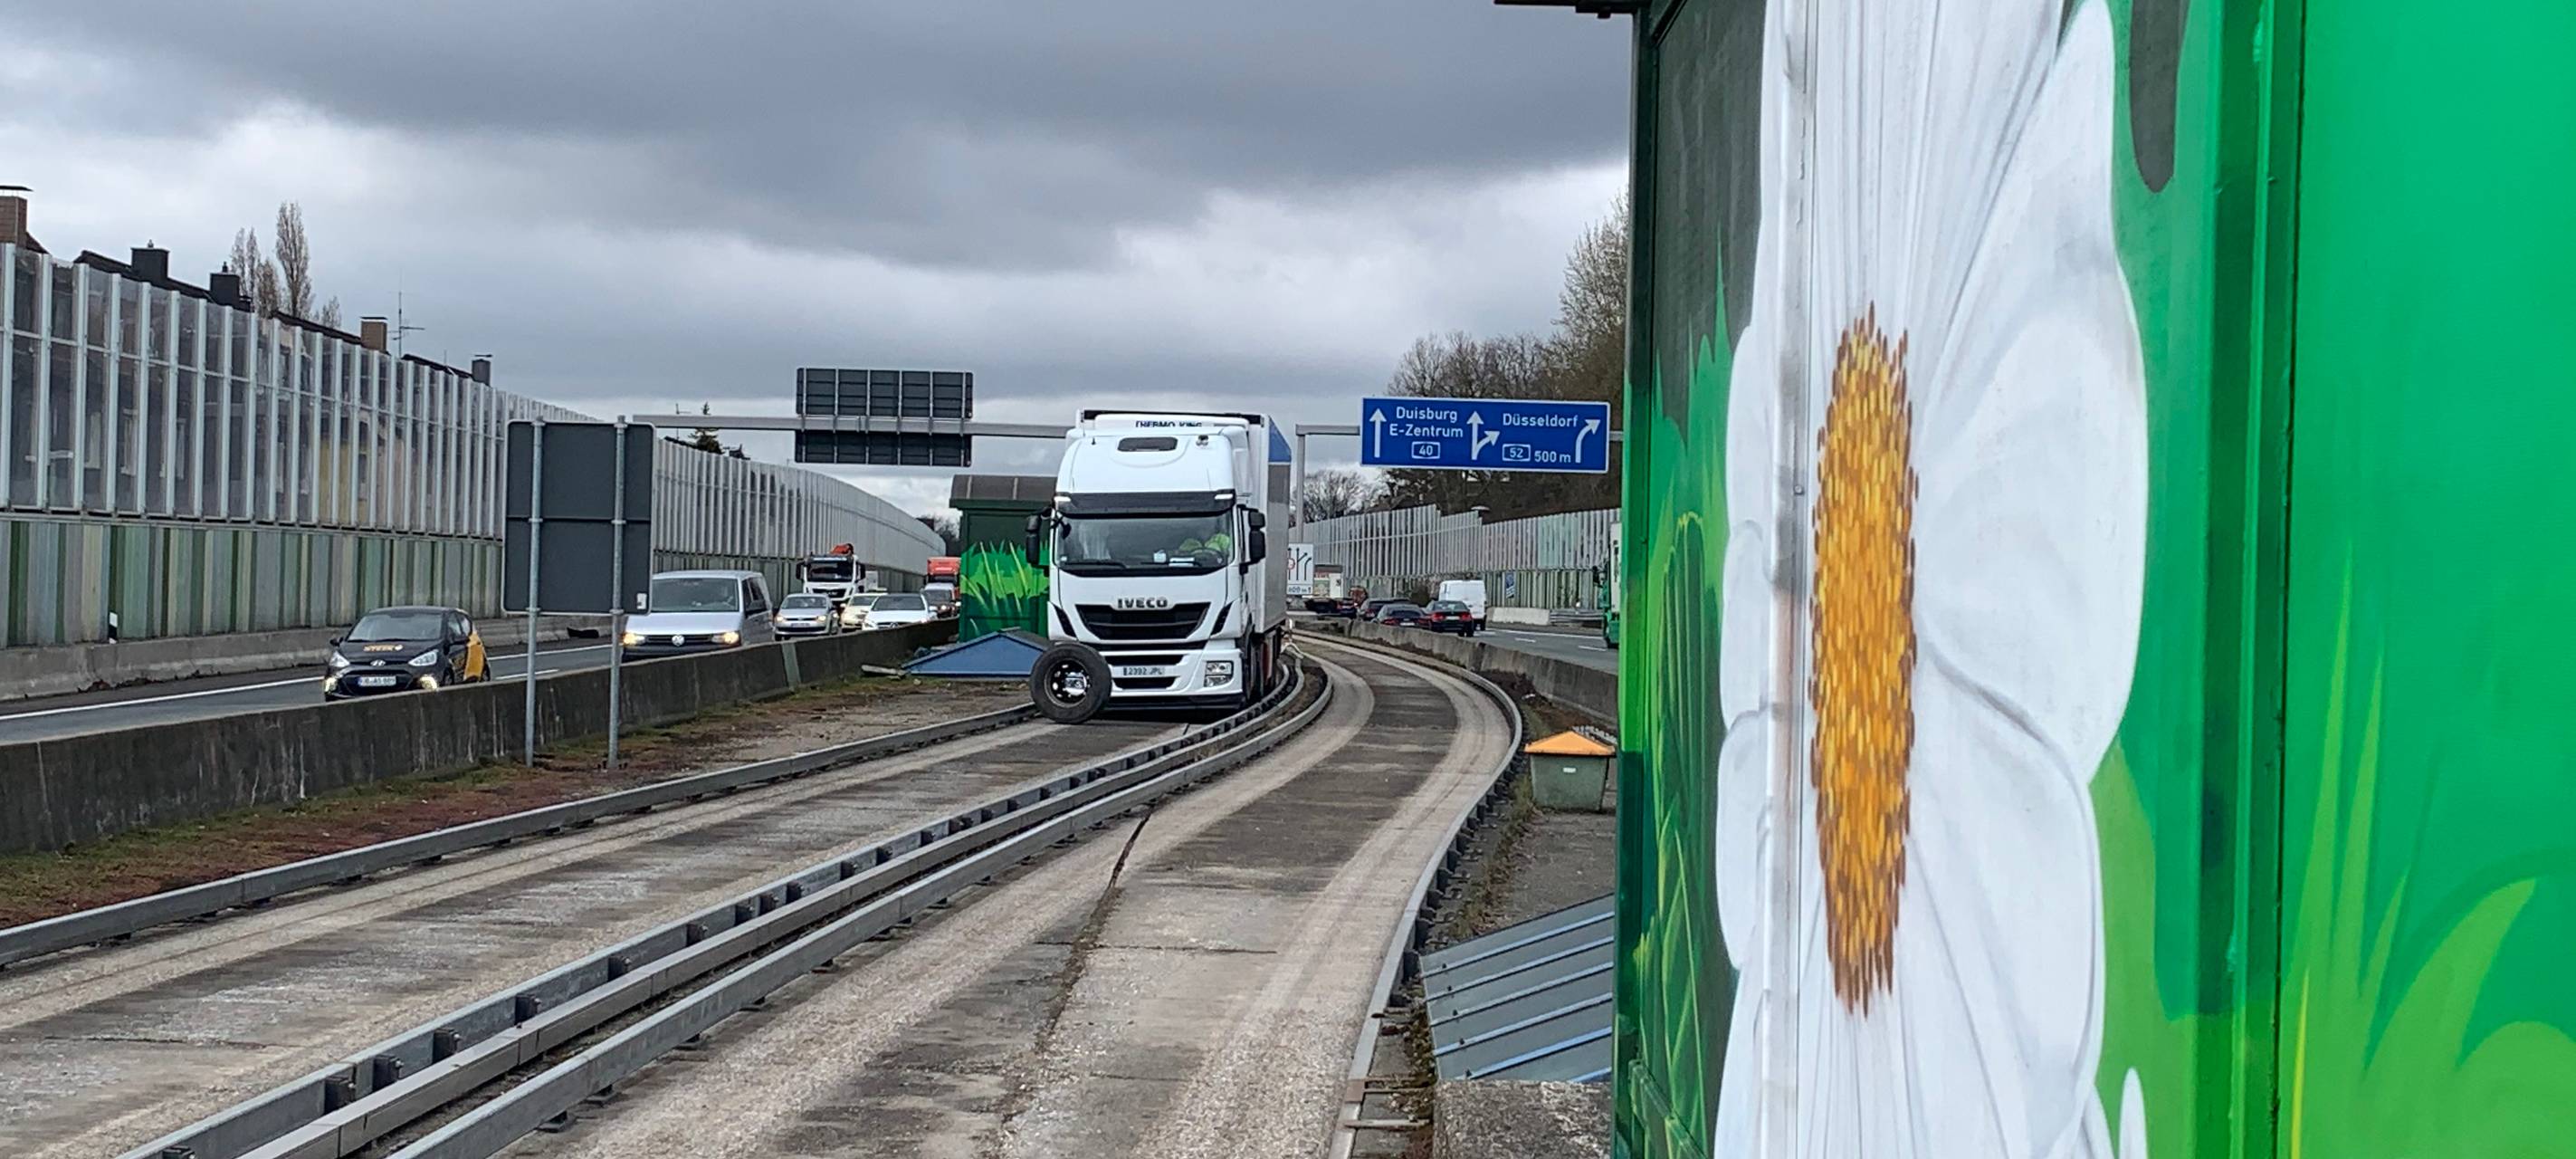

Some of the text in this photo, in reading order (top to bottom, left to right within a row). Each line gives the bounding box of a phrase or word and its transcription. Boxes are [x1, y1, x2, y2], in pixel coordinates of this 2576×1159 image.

[1396, 406, 1458, 424] Duisburg
[1503, 413, 1579, 427] Düsseldorf
[1389, 423, 1464, 437] E-Zentrum
[1418, 445, 1434, 455] 40
[1509, 447, 1524, 458] 52
[1534, 450, 1571, 463] 500 m
[1118, 597, 1168, 608] IVECO
